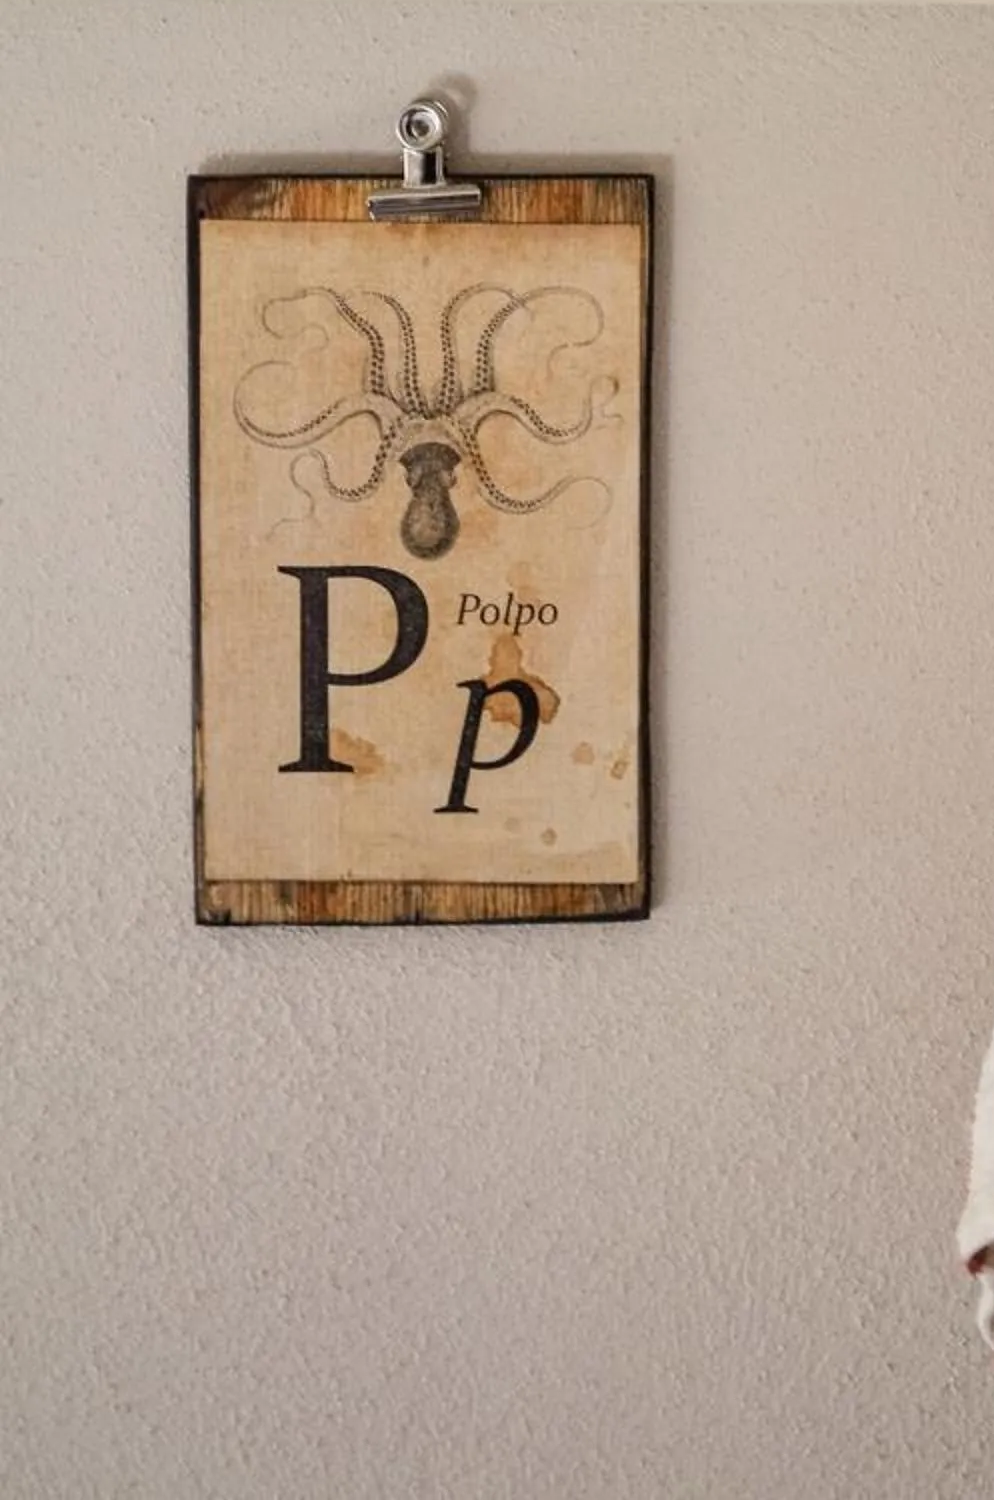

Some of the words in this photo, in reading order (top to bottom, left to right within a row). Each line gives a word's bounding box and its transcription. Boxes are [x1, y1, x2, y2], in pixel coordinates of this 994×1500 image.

[456, 591, 559, 637] Polpo
[277, 565, 429, 773] P
[433, 678, 541, 814] p
